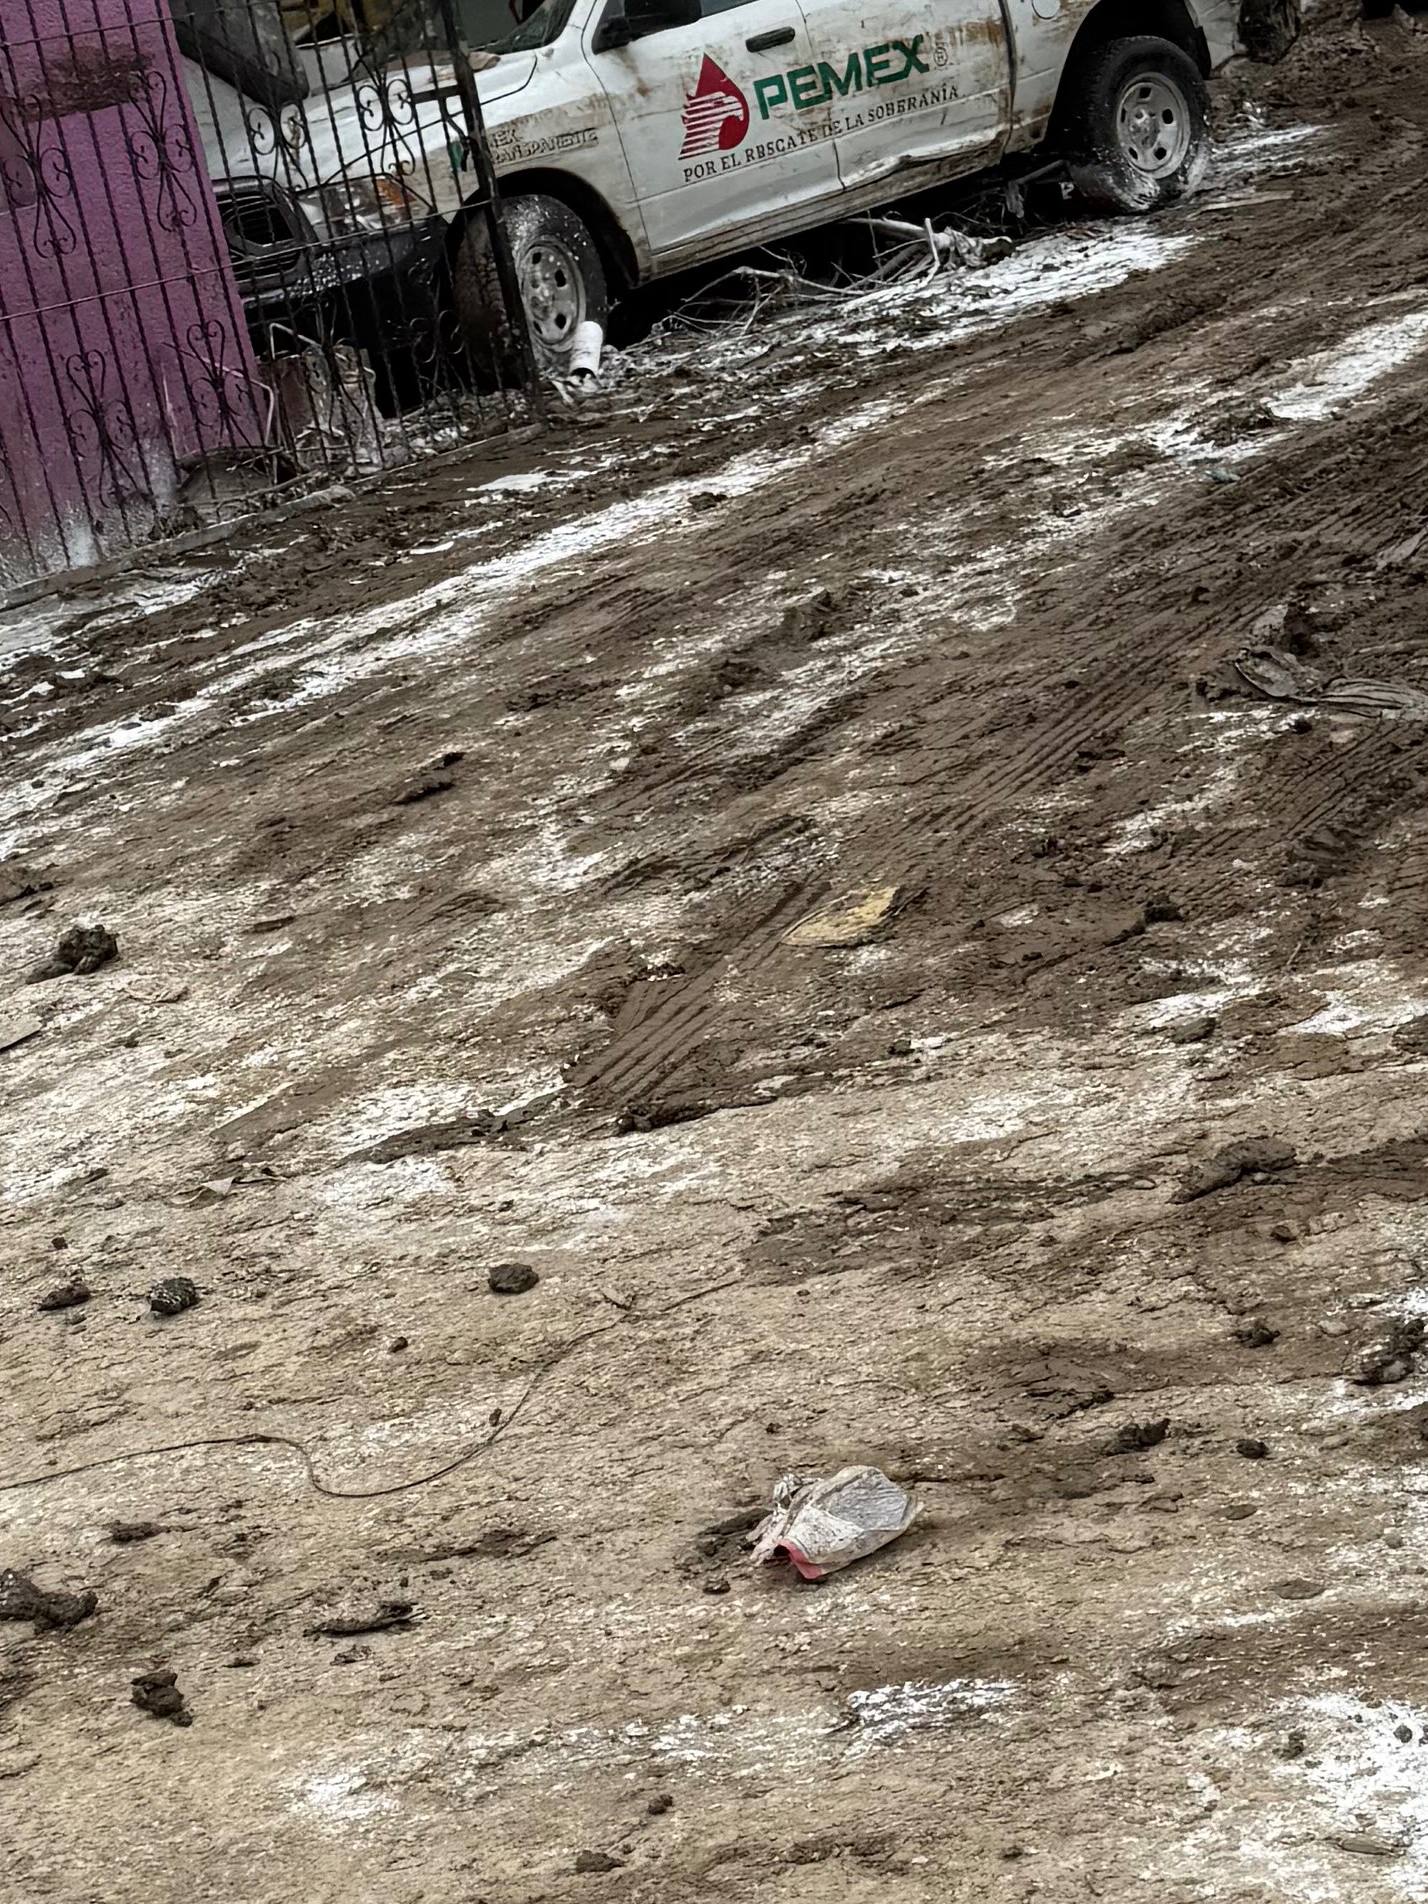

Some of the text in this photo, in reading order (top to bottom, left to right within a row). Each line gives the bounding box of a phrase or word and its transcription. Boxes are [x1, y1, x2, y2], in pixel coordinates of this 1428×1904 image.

[753, 34, 930, 120] PEMEX
[683, 160, 717, 182] POR
[721, 153, 741, 170] EL
[822, 120, 842, 138] DE
[845, 113, 865, 130] LA
[868, 83, 960, 123] SOBERANÍA
